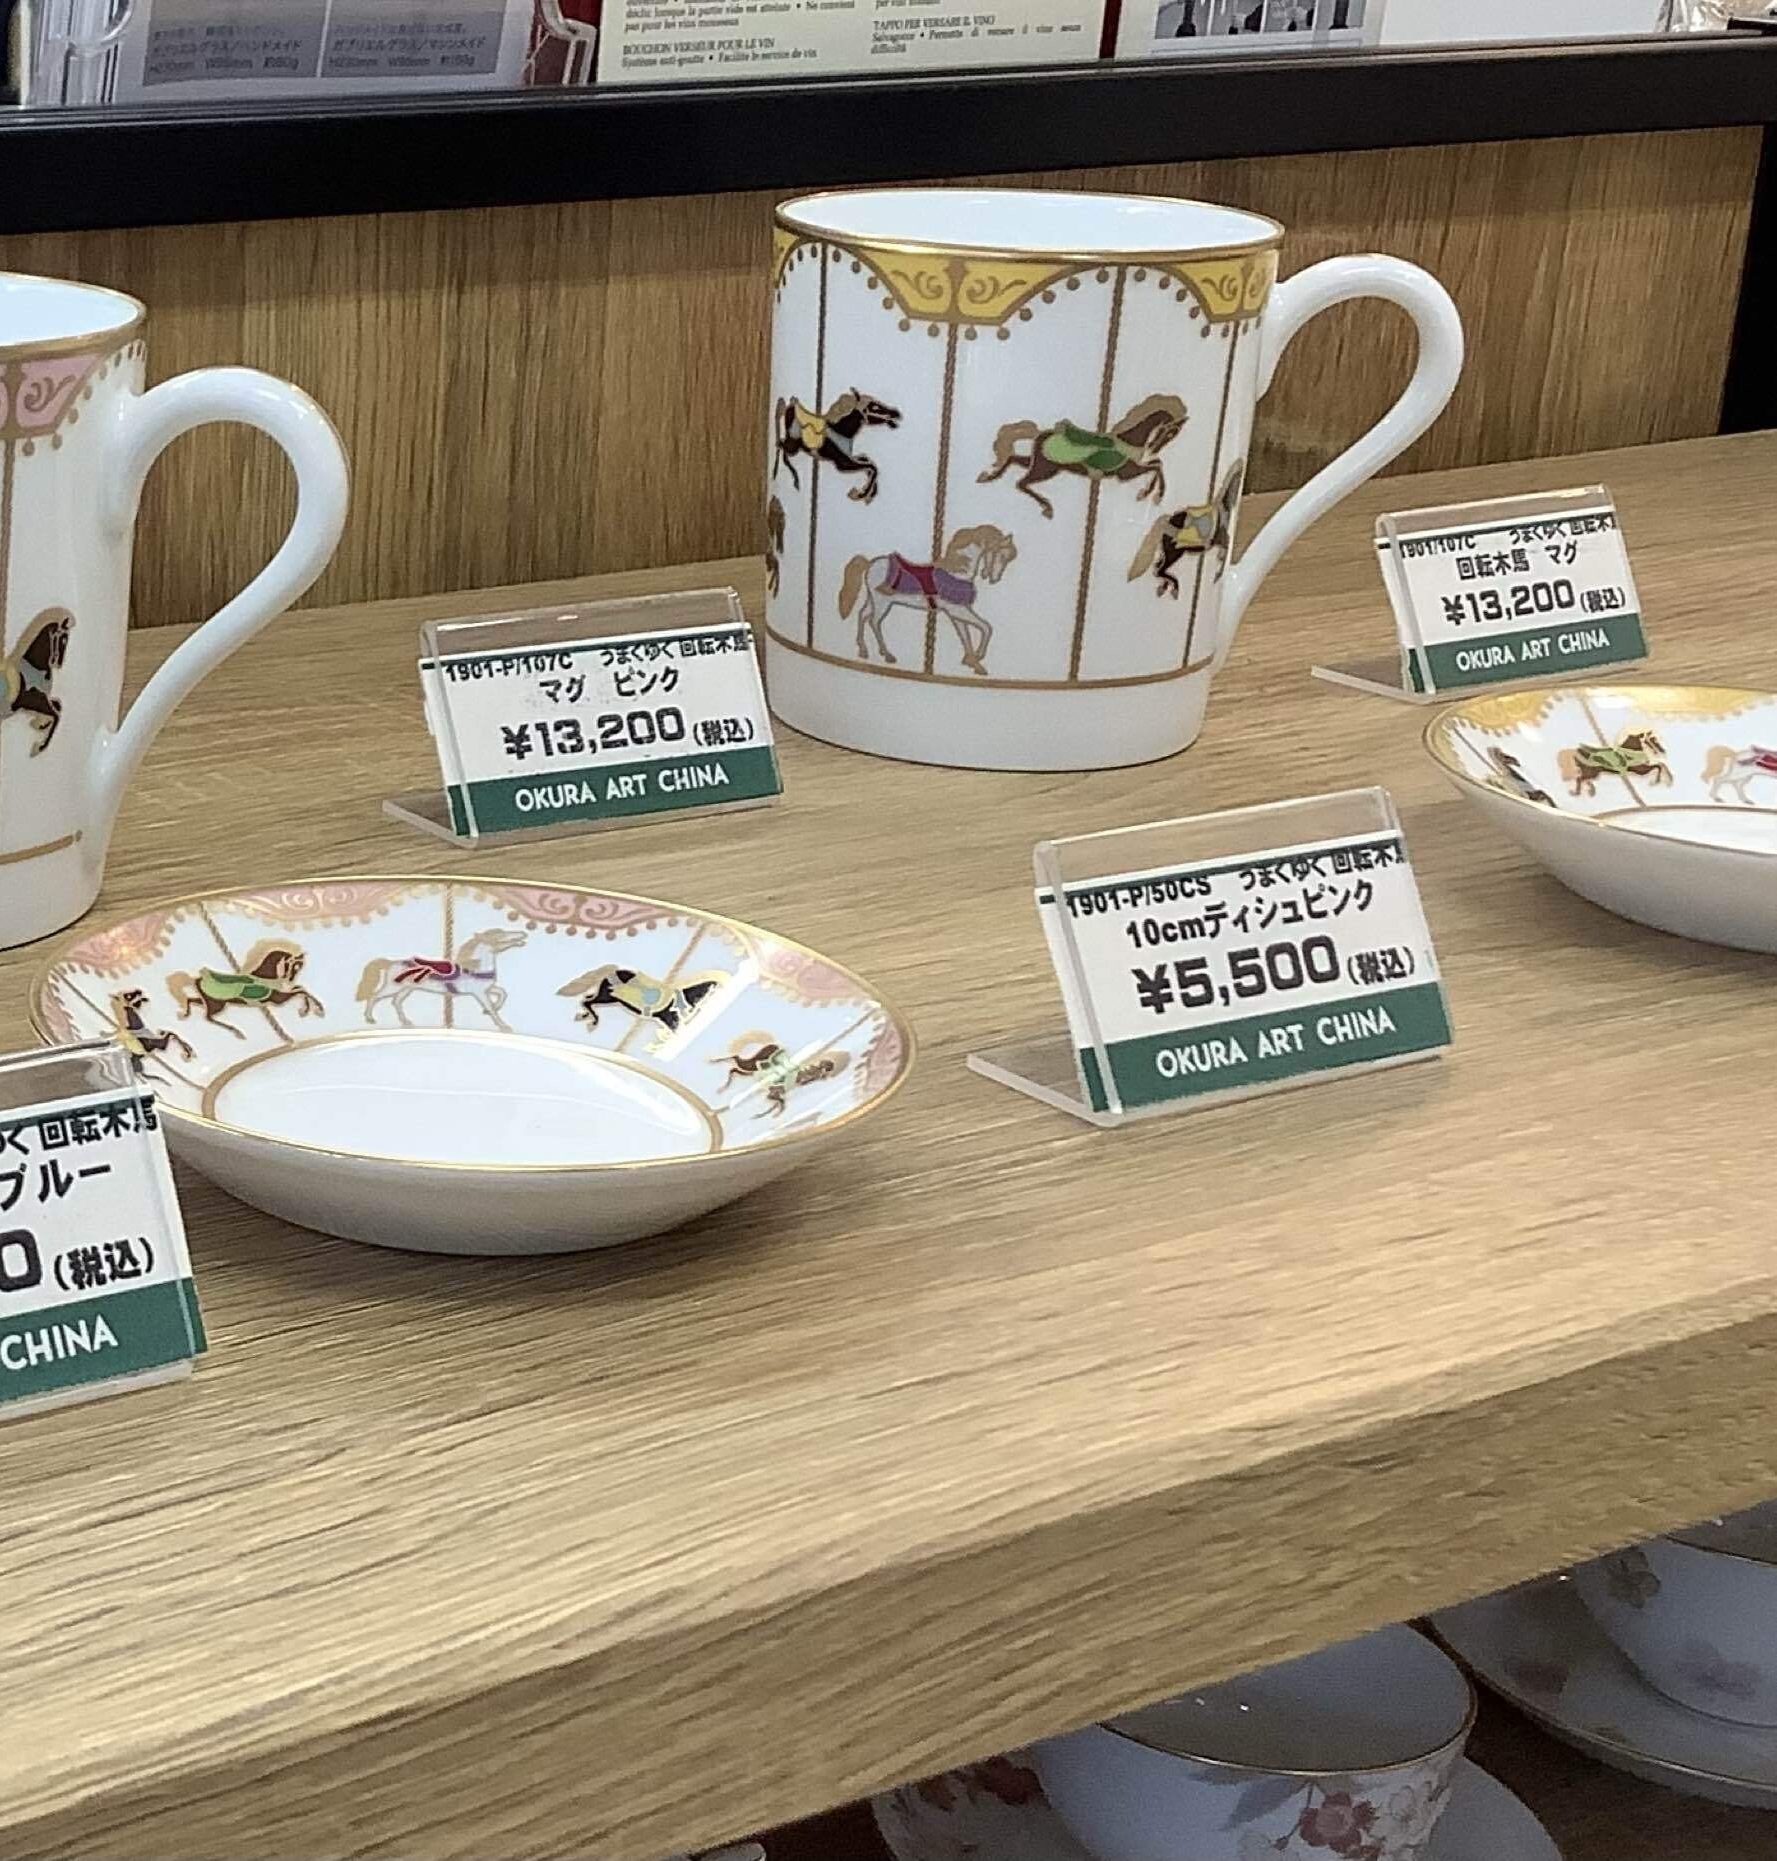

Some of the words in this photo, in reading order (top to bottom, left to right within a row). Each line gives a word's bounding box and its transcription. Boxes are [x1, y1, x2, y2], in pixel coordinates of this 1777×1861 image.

[1456, 549, 1530, 581] 回転木馬
[1545, 540, 1578, 566] マグ
[1441, 579, 1574, 626] ¥13,200
[445, 653, 573, 682] 1901-P/107C
[1456, 644, 1515, 672] OKURA
[1522, 637, 1551, 662] ART
[1557, 628, 1610, 655] CHINA
[539, 674, 585, 703] マグ
[613, 666, 680, 698] ピンク
[500, 706, 685, 761] ¥13,200
[693, 717, 754, 748] (税込)
[515, 784, 597, 813] OKURA
[606, 773, 648, 801] ART
[658, 763, 730, 793] CHINA
[1066, 876, 1212, 919] 1901-P/50CS
[1132, 935, 1341, 1014] ¥5,500
[1347, 945, 1415, 986] (税込)
[1156, 1038, 1248, 1079] OKURA
[1258, 1024, 1304, 1058] ART
[1317, 1005, 1396, 1043] CHINA
[53, 1236, 154, 1292] (税込)
